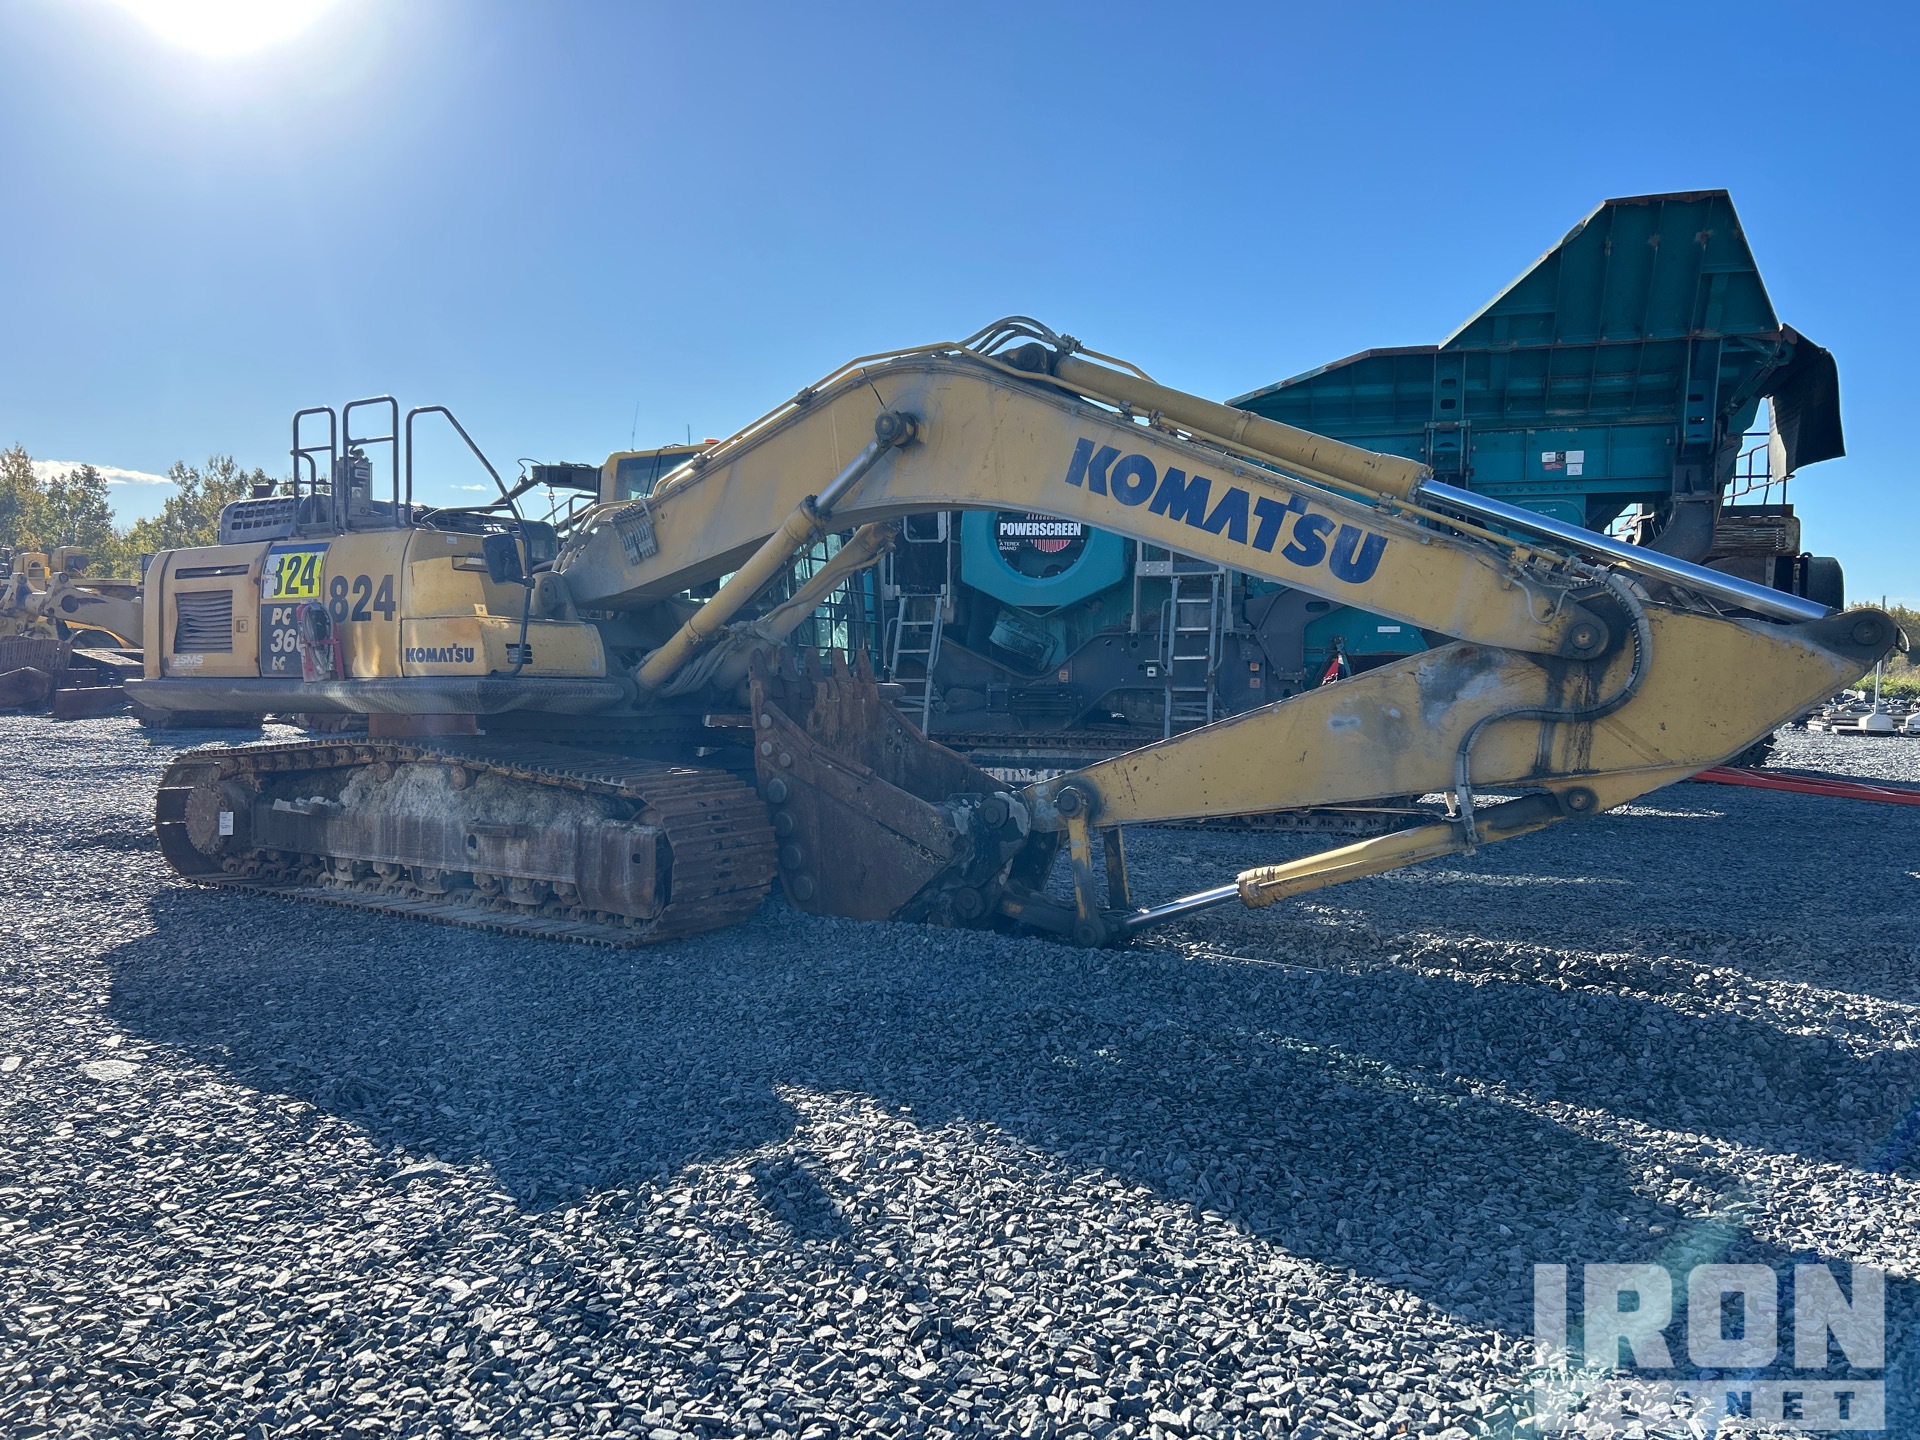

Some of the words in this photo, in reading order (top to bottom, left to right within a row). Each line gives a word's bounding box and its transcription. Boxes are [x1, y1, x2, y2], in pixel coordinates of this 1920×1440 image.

[1064, 436, 1389, 584] KOMATSU
[999, 522, 1082, 536] POWERSCREEN
[328, 574, 397, 623] 824
[270, 607, 292, 626] PC
[179, 654, 204, 665] SMS
[405, 643, 474, 663] KOMATSU
